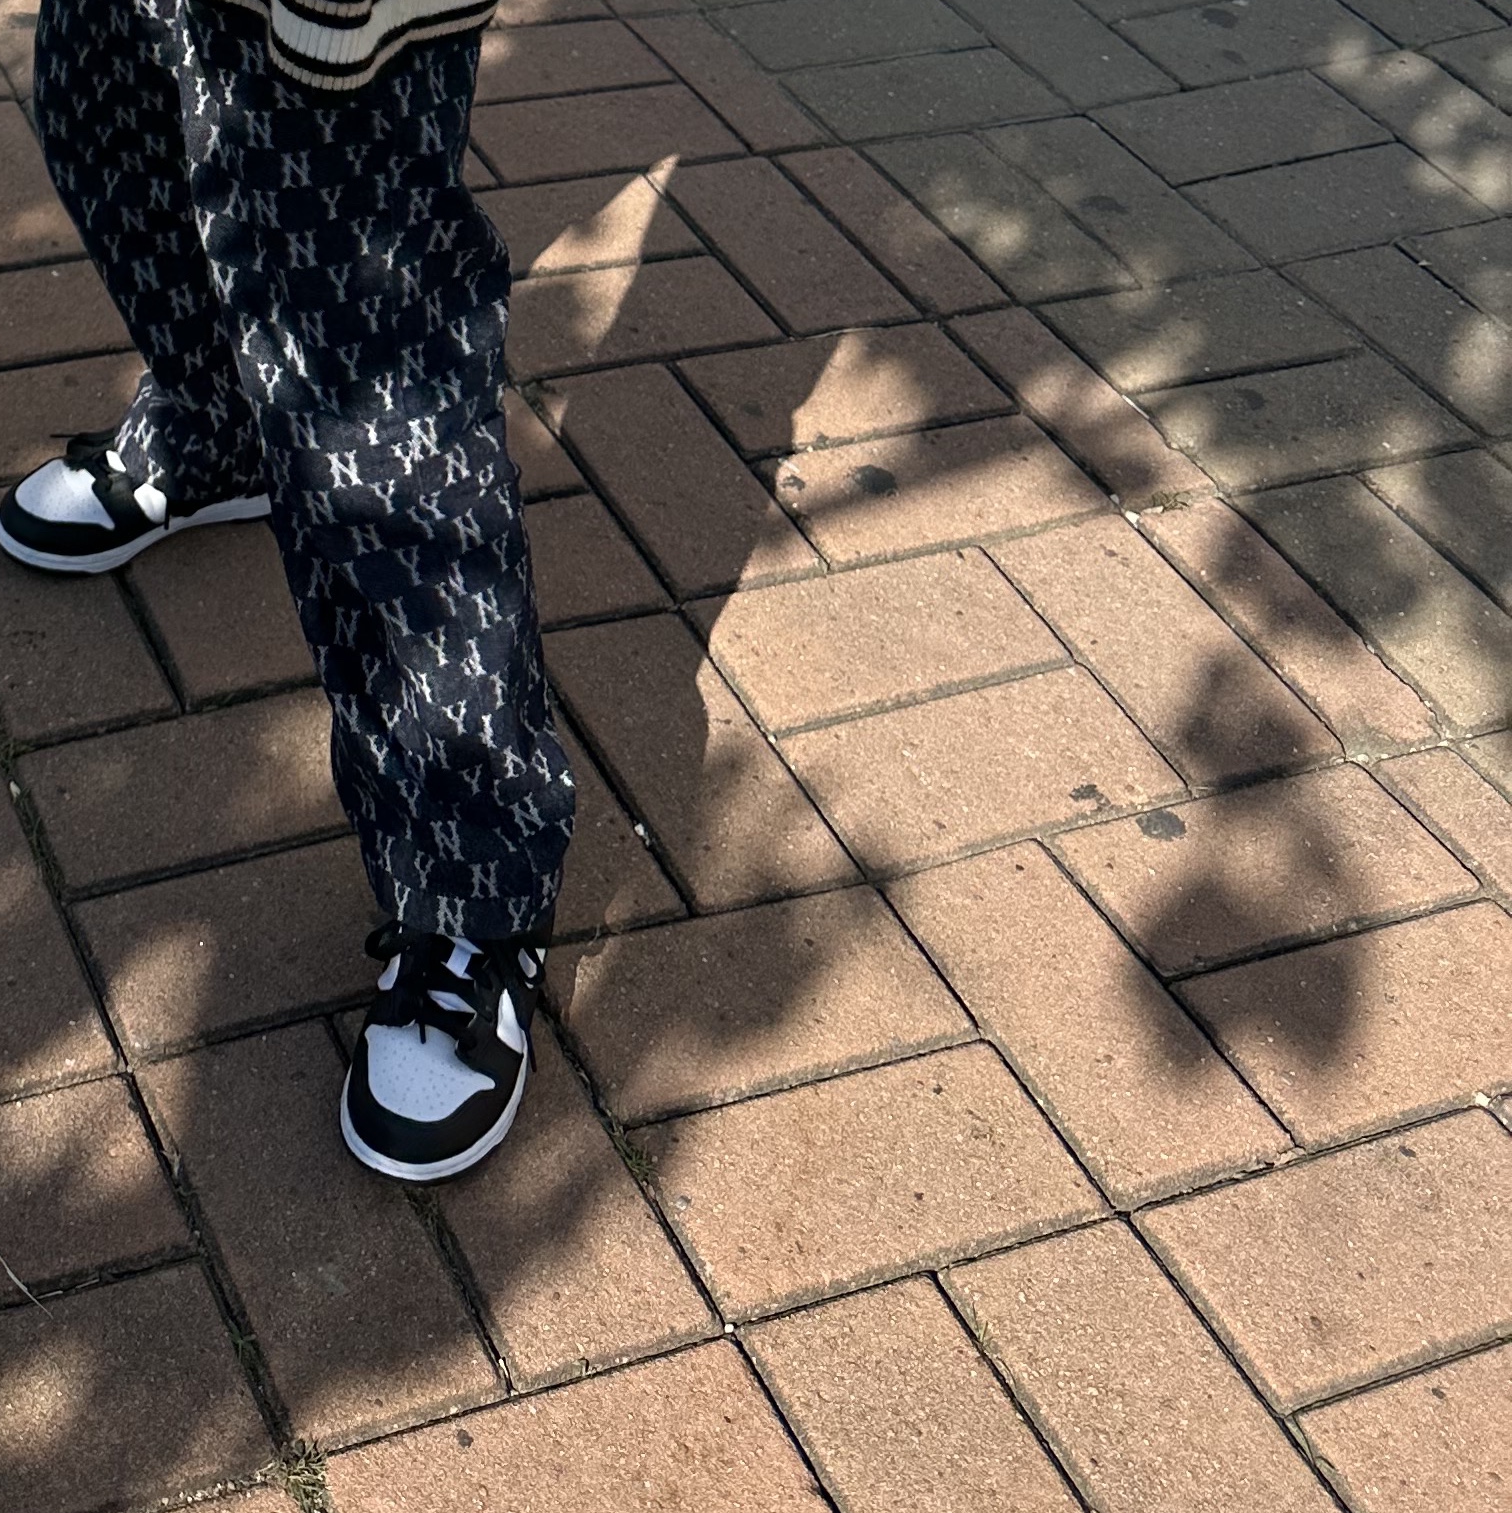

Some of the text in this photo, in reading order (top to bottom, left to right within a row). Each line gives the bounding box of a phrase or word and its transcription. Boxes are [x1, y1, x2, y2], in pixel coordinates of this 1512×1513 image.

[110, 5, 129, 36] N
[50, 55, 67, 87] N
[74, 43, 90, 67] Y
[237, 39, 265, 74] N
[72, 93, 88, 120] Y
[92, 73, 111, 102] Y
[393, 76, 412, 117] Y
[48, 111, 67, 139] N
[95, 125, 113, 147] Y
[115, 106, 137, 129] N
[243, 110, 274, 149] N
[314, 109, 338, 144] Y
[419, 111, 445, 156] N
[119, 151, 144, 172] N
[144, 133, 166, 157] N
[345, 144, 371, 177] Y
[53, 162, 76, 191] N
[102, 167, 121, 201] Y
[281, 150, 312, 188] N
[82, 197, 98, 228] Y
[148, 177, 172, 210] N
[253, 189, 281, 228] N
[319, 184, 344, 221] Y
[407, 187, 437, 226] N
[120, 205, 147, 232] N
[193, 204, 216, 252] Y
[350, 216, 376, 256] Y
[426, 220, 463, 253] N
[103, 234, 120, 263] Y
[285, 229, 318, 269] N
[131, 257, 160, 292] N
[327, 263, 352, 303] Y
[400, 259, 422, 307] N
[119, 294, 137, 326] Y
[168, 283, 196, 320] N
[359, 295, 382, 334] Y
[425, 287, 443, 335] N
[148, 324, 176, 355] N
[239, 313, 259, 357] Y
[299, 310, 328, 347] N
[448, 316, 475, 356] Y
[183, 344, 204, 377] N
[256, 356, 283, 404] Y
[336, 342, 362, 381] Y
[400, 342, 426, 388] N
[371, 372, 394, 412] Y
[286, 410, 320, 450] N
[408, 415, 440, 462] N
[325, 449, 363, 489] N
[445, 443, 470, 487] N
[303, 491, 338, 524] N
[368, 479, 396, 515] Y
[348, 524, 386, 556] N
[452, 508, 484, 553] N
[394, 545, 423, 586] Y
[491, 531, 508, 572] Y
[307, 557, 339, 599] N
[375, 596, 414, 638] N
[471, 584, 503, 631] N
[334, 606, 361, 649] N
[422, 625, 449, 668] Y
[333, 694, 361, 734] N
[441, 699, 467, 736] Y
[366, 734, 389, 775] Y
[396, 779, 421, 818] Y
[458, 764, 482, 796] Y
[509, 792, 546, 837] N
[430, 820, 465, 861] N
[414, 850, 435, 889] Y
[469, 860, 499, 898] N
[393, 878, 411, 922] Y
[436, 895, 466, 936] N
[508, 896, 530, 933] Y
